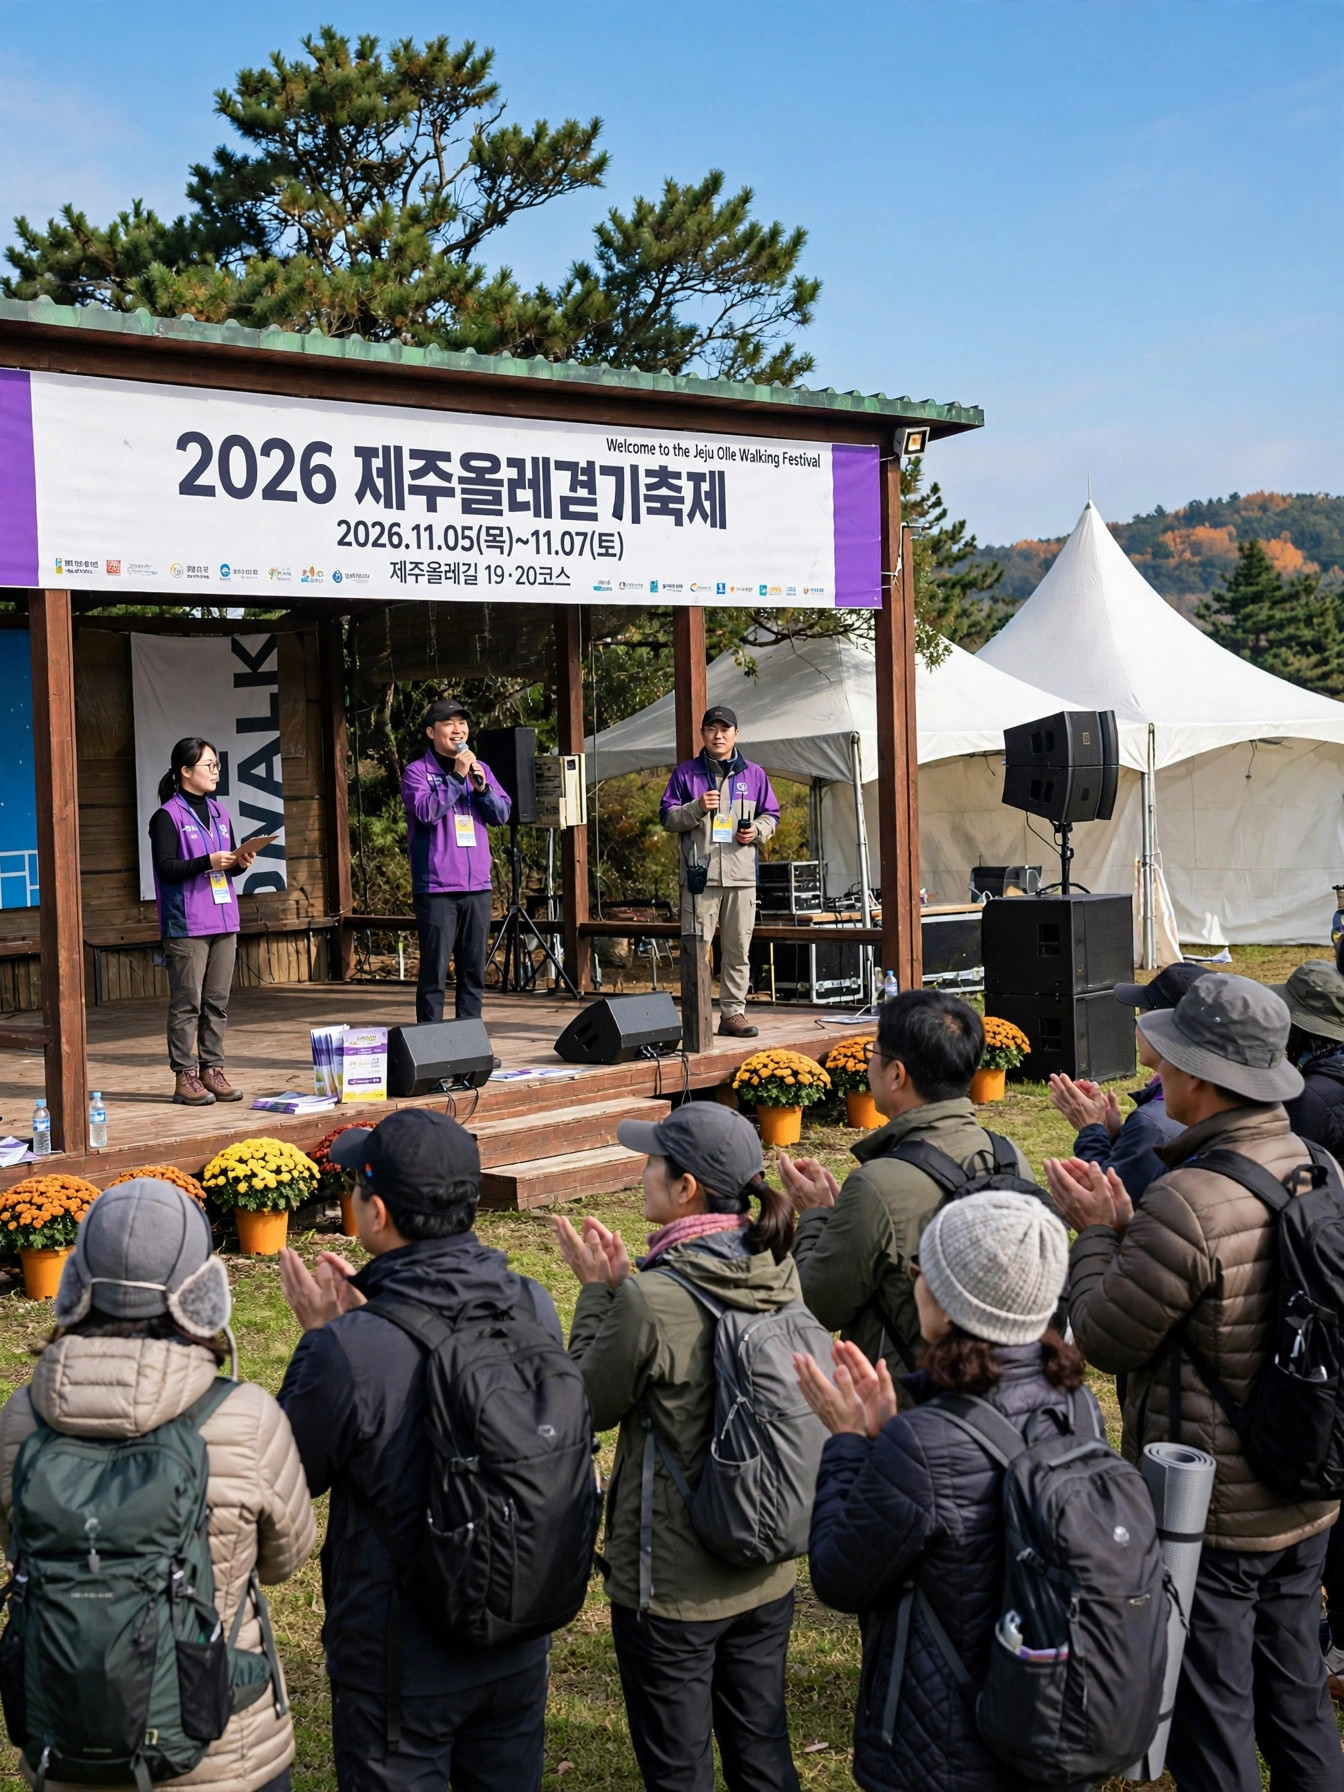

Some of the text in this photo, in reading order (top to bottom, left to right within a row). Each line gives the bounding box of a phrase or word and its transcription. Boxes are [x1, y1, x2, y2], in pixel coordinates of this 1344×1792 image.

[176, 430, 337, 505] 2026
[606, 437, 821, 469] Welcome to the Jeju Olle Walking Festival
[337, 519, 624, 563] 2026.11.05(목)~11.07(토)
[389, 560, 479, 586] 제주올레길
